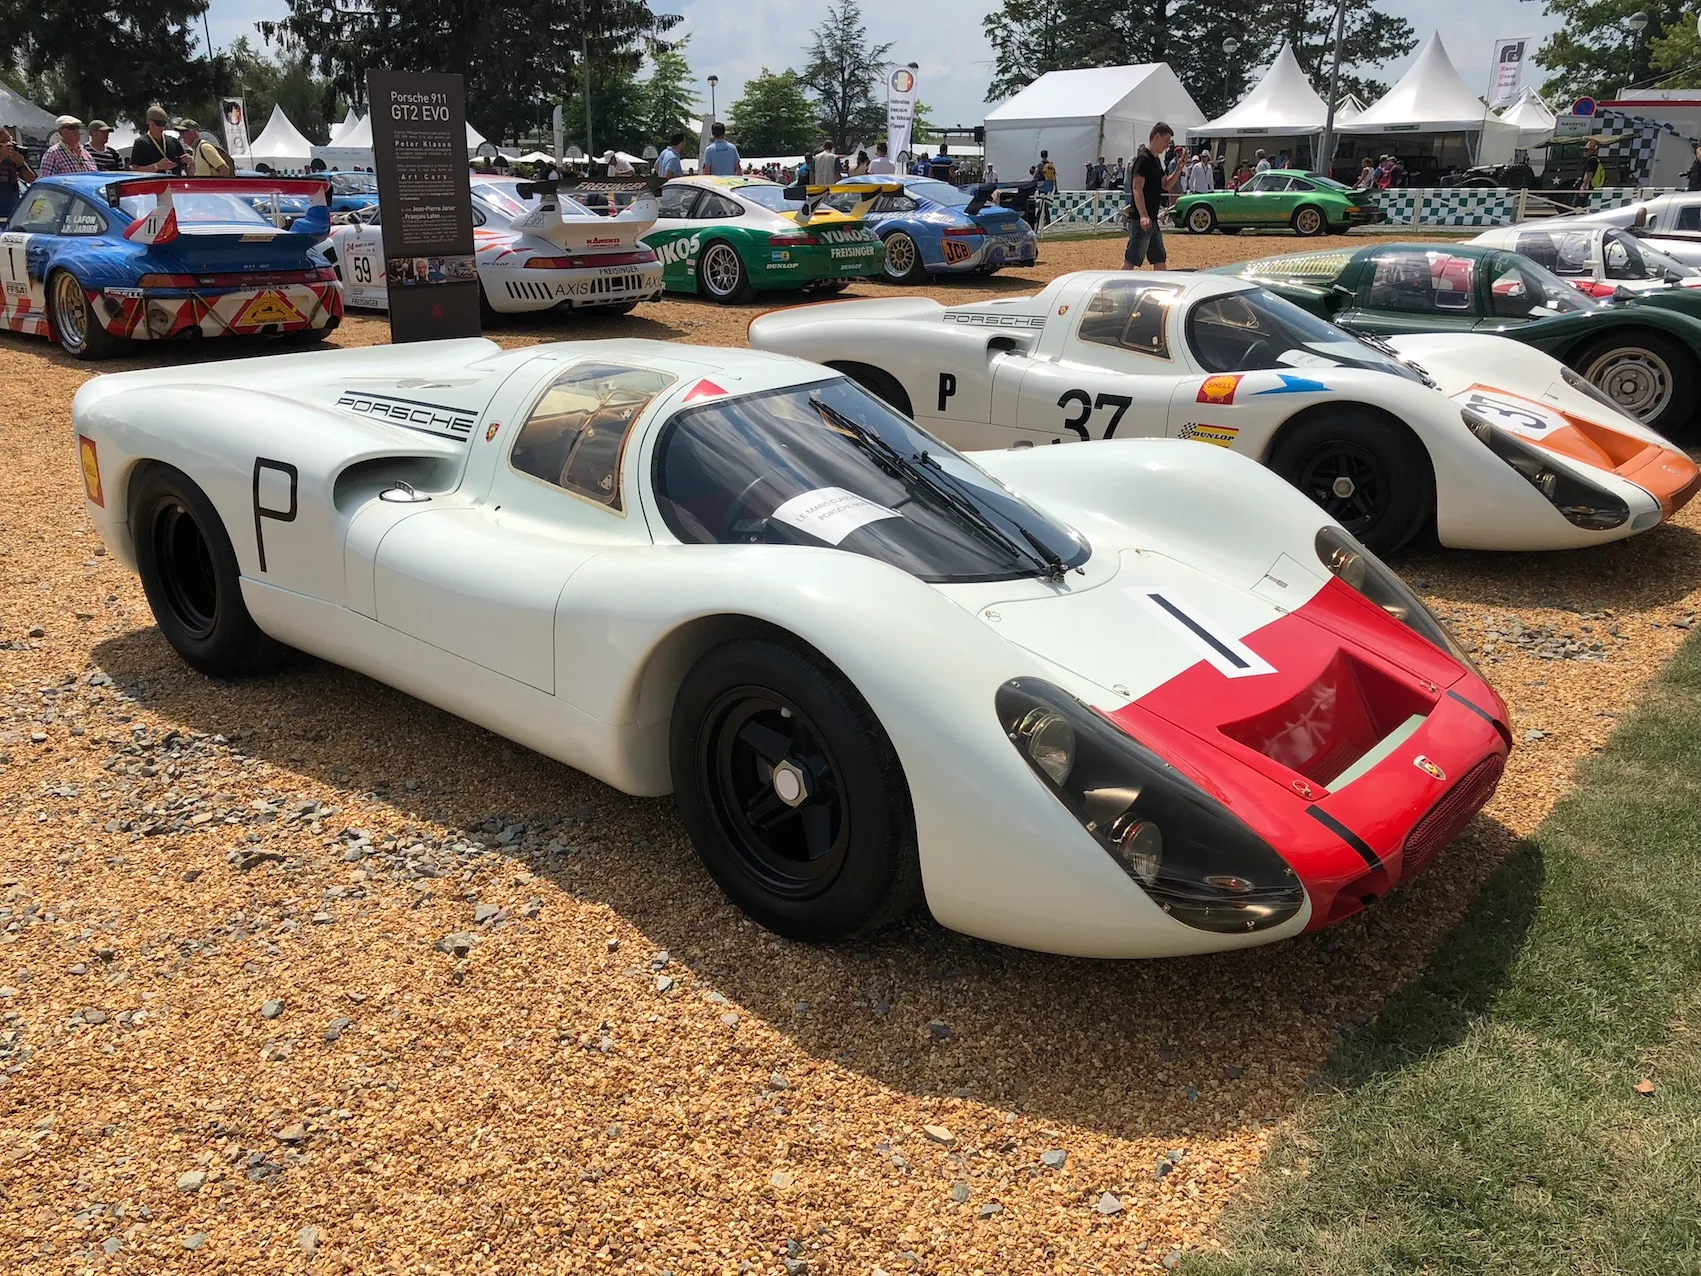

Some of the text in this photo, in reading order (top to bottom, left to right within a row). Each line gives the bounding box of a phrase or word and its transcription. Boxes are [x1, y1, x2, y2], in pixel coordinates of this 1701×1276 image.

[391, 91, 447, 103] Porsche 911
[391, 104, 450, 121] GT2 EVO
[917, 165, 925, 176] 5
[574, 182, 647, 192] FREISINGER
[73, 216, 97, 224] LAFON
[73, 225, 98, 233] JARIER
[820, 226, 872, 244] YUKOS
[653, 233, 701, 267] UKOS
[831, 246, 875, 258] FREISINGER
[947, 240, 970, 260] JCB
[8, 247, 15, 280] 1
[354, 256, 372, 283] 59
[599, 266, 639, 275] FREISINGER
[351, 298, 379, 307] FREISINGER
[943, 314, 1045, 326] PORSCHE
[938, 372, 957, 411] P
[334, 397, 475, 433] PORSCHE
[1056, 389, 1133, 444] 37
[1465, 394, 1548, 430] 37
[1191, 430, 1235, 441] DUNLOP
[253, 456, 298, 573] P
[796, 513, 807, 523] LE
[806, 499, 830, 514] MANS
[818, 503, 852, 521] PORSCHE
[1146, 593, 1251, 669] 1
